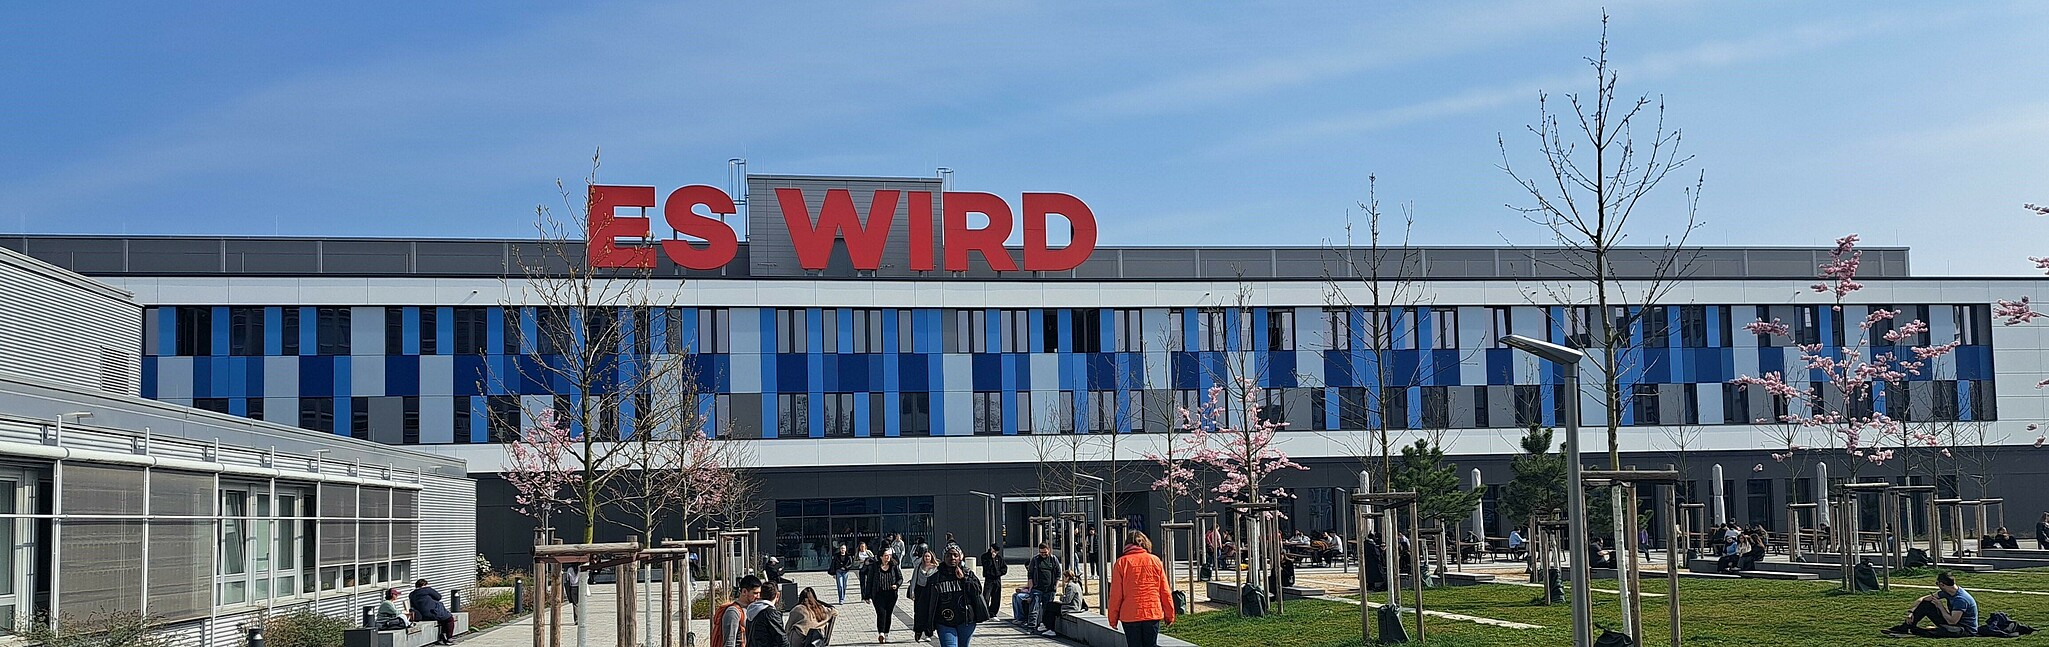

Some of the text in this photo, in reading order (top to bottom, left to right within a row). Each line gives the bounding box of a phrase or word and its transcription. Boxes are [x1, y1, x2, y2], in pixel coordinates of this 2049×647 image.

[588, 185, 1098, 271] ES WIRD
[934, 580, 962, 593] NIRVA
